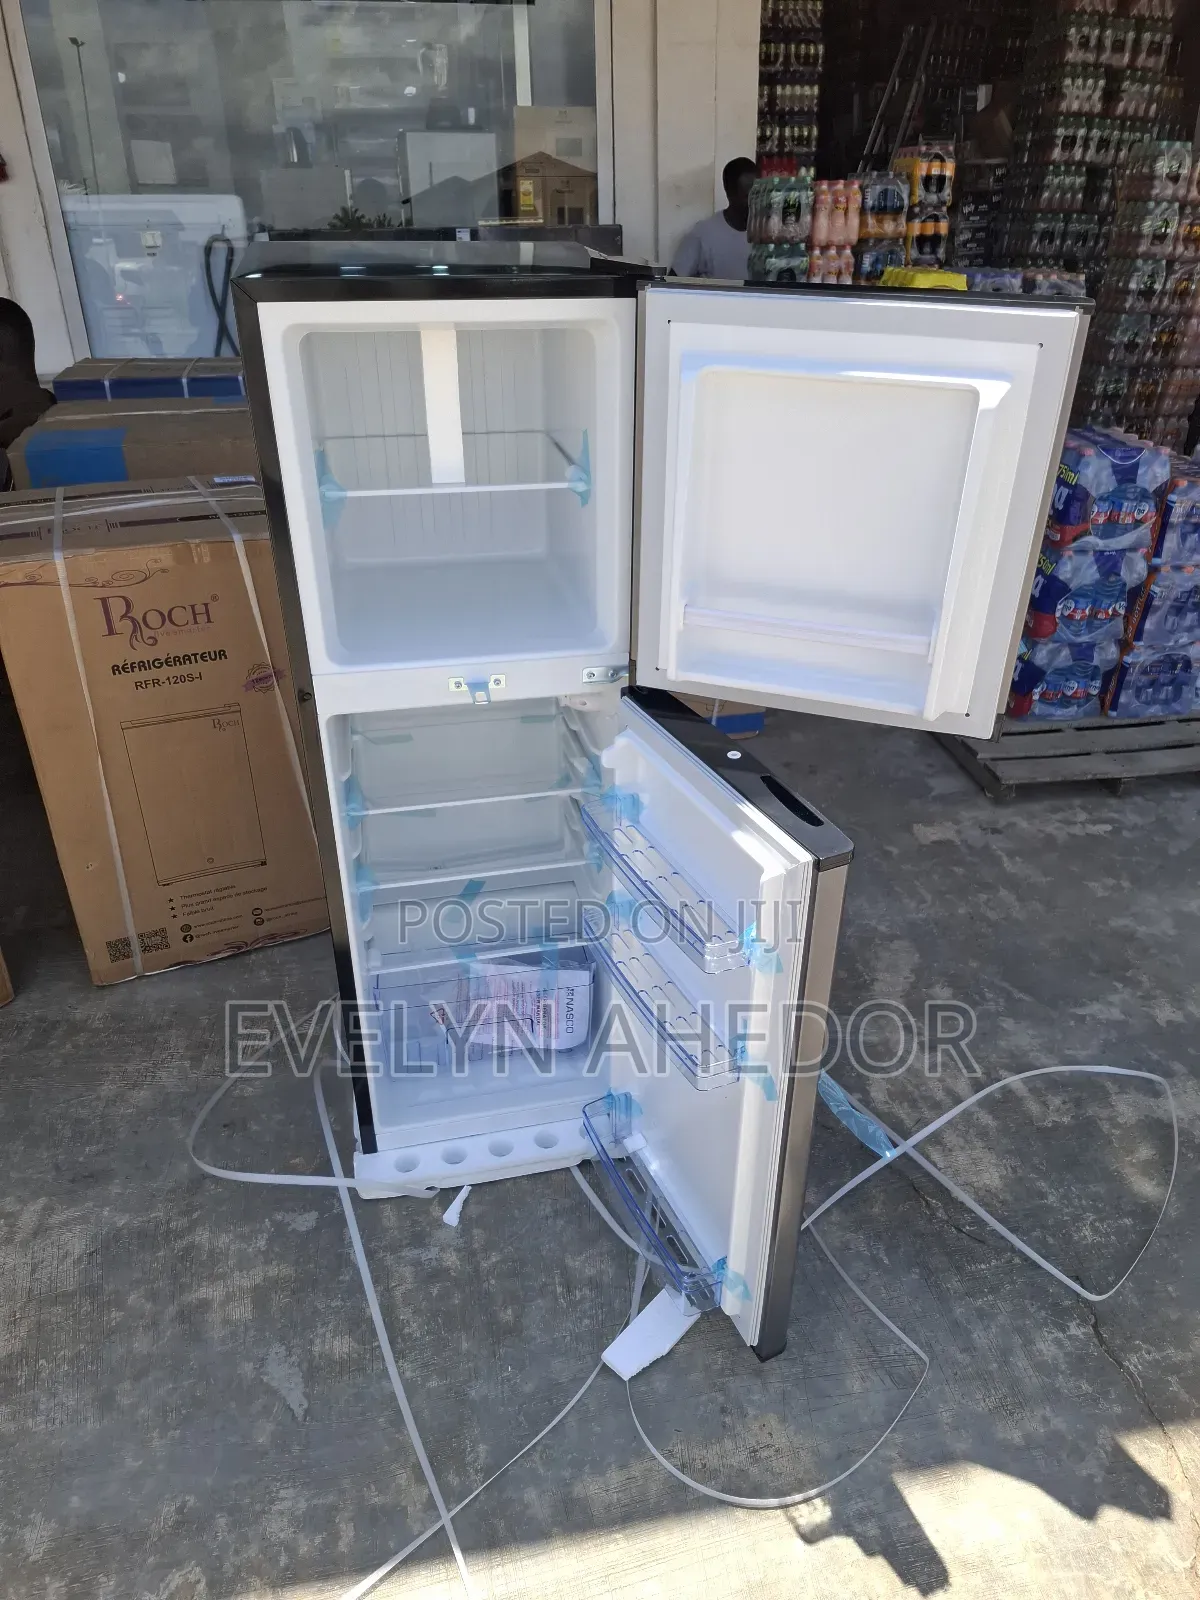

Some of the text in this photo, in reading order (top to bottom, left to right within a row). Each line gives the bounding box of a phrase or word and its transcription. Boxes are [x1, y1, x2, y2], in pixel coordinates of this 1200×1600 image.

[93, 595, 214, 651] ROCH
[111, 649, 228, 676] RÉFRIGÉRATEUR
[134, 672, 203, 691] RFR-120S-I
[566, 1000, 574, 1034] NASCO
